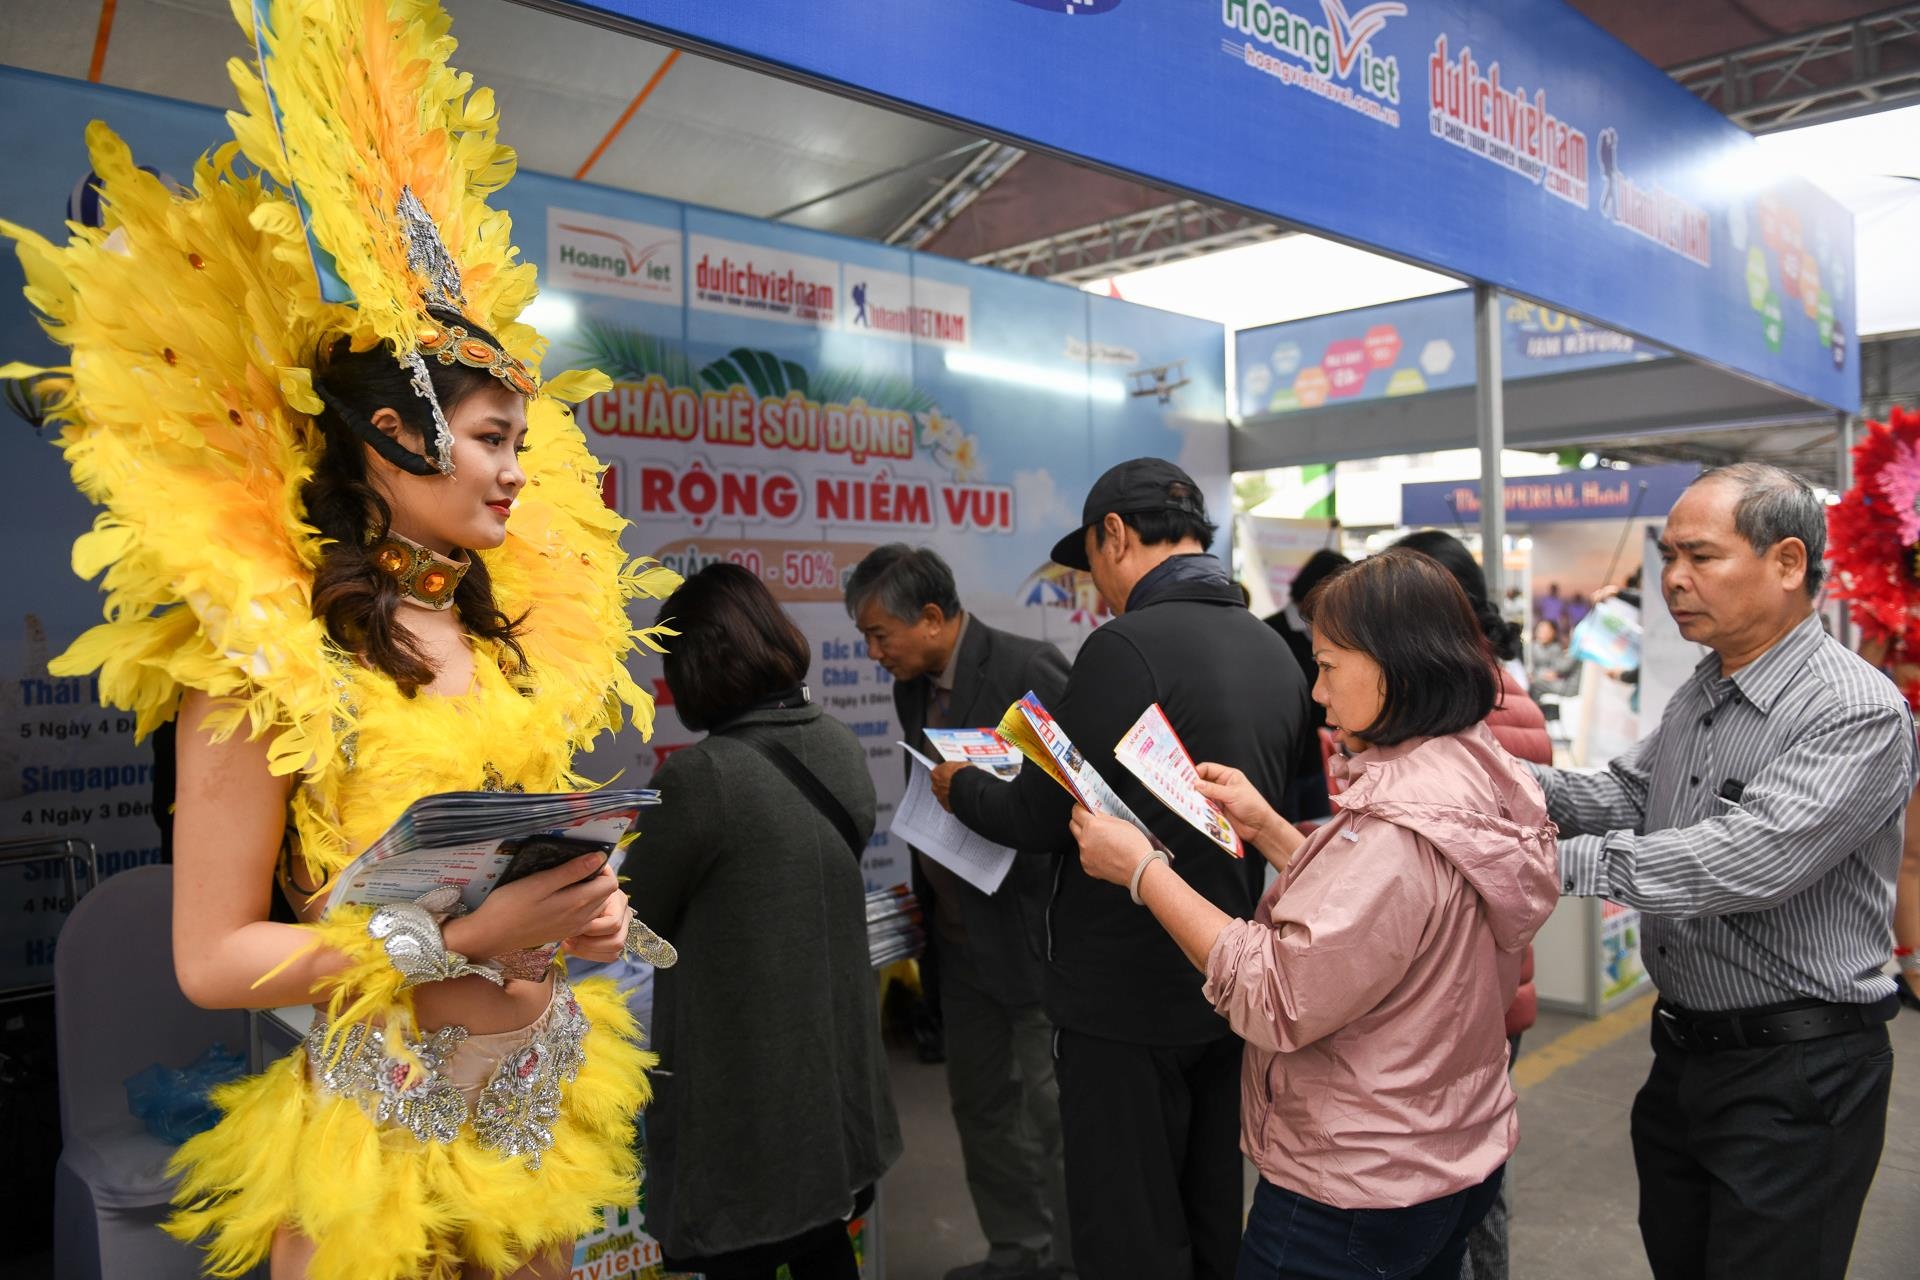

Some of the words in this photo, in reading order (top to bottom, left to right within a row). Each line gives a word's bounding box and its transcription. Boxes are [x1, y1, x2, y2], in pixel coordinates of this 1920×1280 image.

[1224, 0, 1405, 101] HoangViet
[1431, 36, 1586, 184] dulichvietnam
[560, 236, 674, 282] HoangViet
[696, 255, 833, 309] dulichvietnam
[591, 377, 698, 441] CHÀO
[705, 383, 755, 446] HÈ
[758, 392, 822, 452] SÔI
[825, 400, 913, 465] ĐỘNG
[641, 461, 798, 526] RỘNG
[816, 469, 930, 525] NIỀM
[944, 488, 1011, 529] VUI
[784, 554, 833, 585] 50%
[20, 677, 80, 705] Thái
[20, 723, 31, 738] 5
[40, 720, 91, 740] Ngày
[98, 719, 109, 733] 4
[21, 810, 33, 824] 4
[40, 806, 92, 827] Ngày
[99, 803, 111, 819] 3
